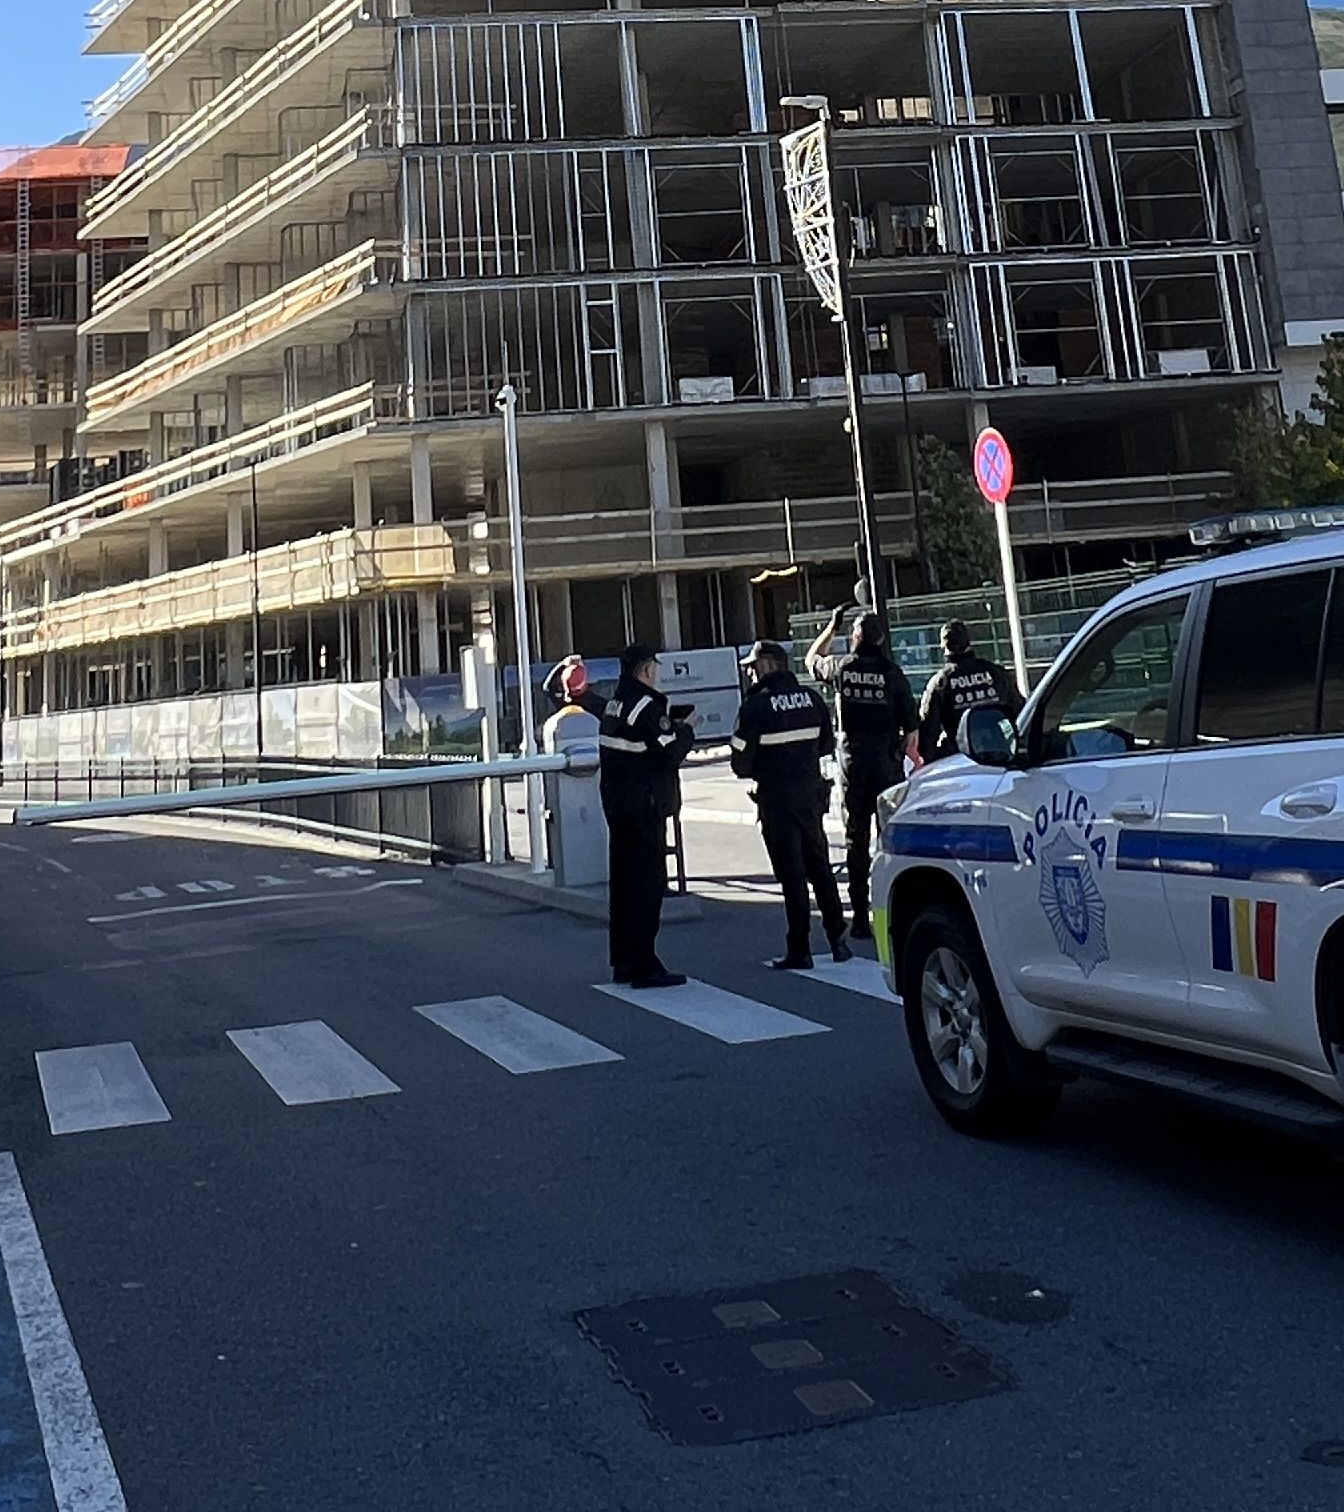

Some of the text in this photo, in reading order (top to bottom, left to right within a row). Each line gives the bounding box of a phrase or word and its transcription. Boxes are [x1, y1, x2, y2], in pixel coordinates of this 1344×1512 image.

[843, 670, 886, 687] POLICIA
[950, 671, 994, 689] POLICIA
[770, 692, 814, 712] POLICIA
[1023, 789, 1106, 871] POLICIA
